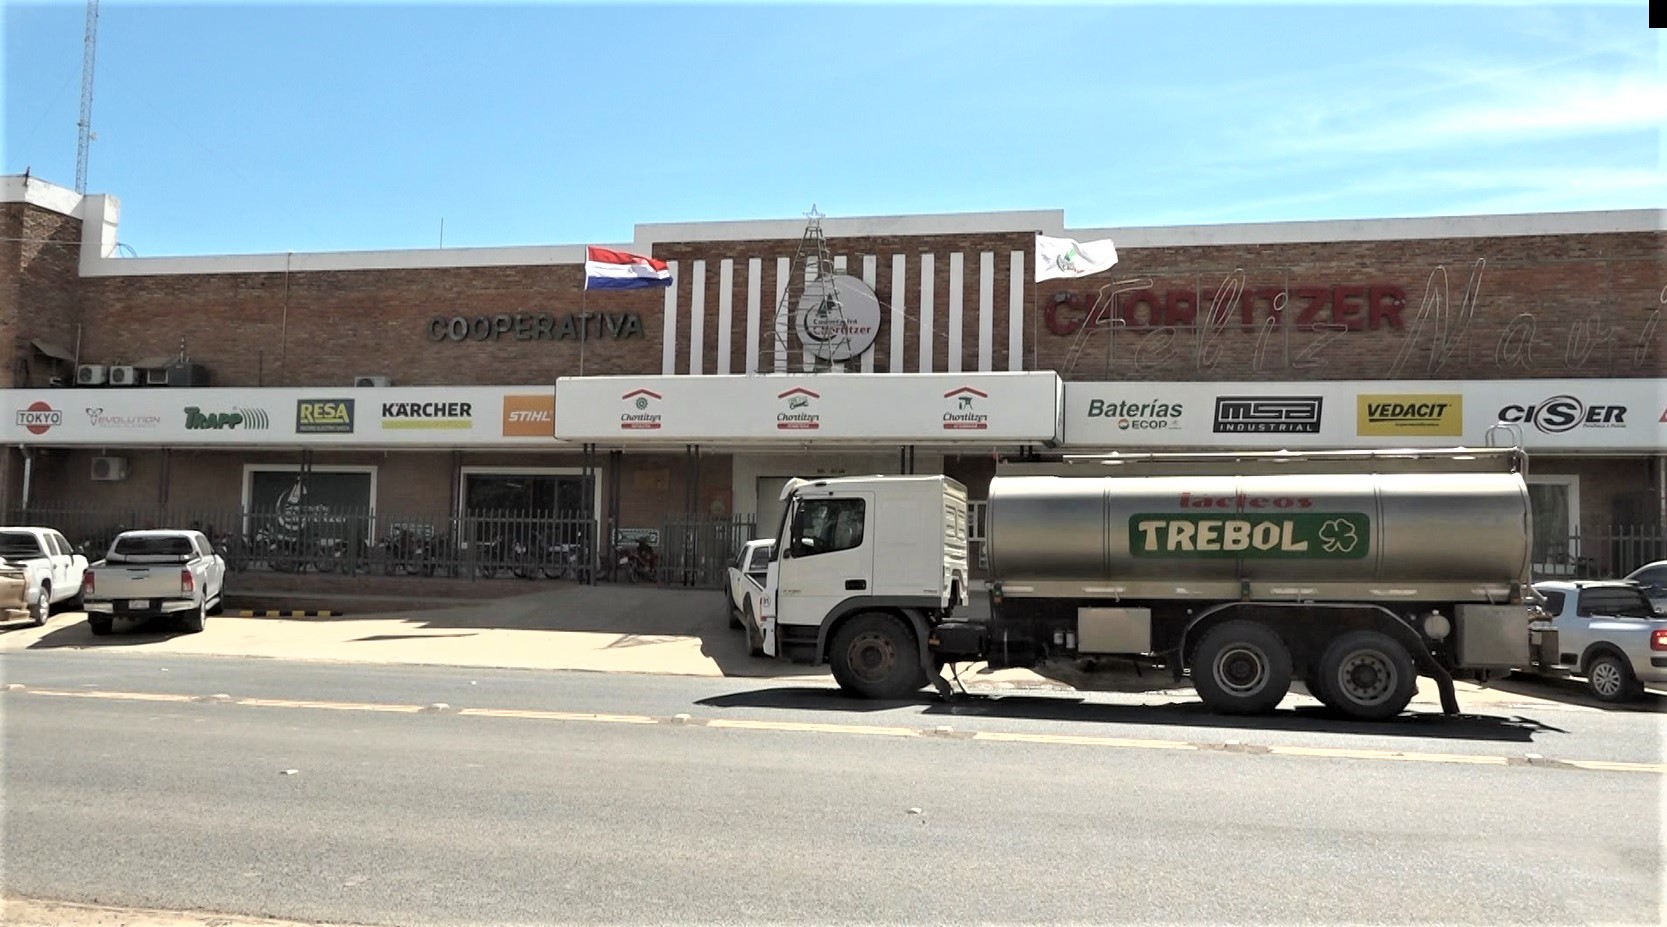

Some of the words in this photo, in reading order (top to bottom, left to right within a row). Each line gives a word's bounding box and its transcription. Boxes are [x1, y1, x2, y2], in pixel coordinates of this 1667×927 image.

[1045, 284, 1406, 336] CHORTITZER
[428, 312, 645, 341] COOPERATIVA
[300, 403, 350, 423] RESA
[382, 402, 472, 418] KÄRCHER
[508, 410, 551, 421] STIHL
[1087, 398, 1183, 418] Baterías
[1367, 402, 1448, 418] VEDACIT
[1498, 402, 1628, 426] CISER
[19, 411, 60, 424] TOKYO
[1131, 419, 1168, 430] ECOP
[1219, 423, 1313, 432] INDUSTRIAL
[1138, 520, 1309, 552] TREBOL
